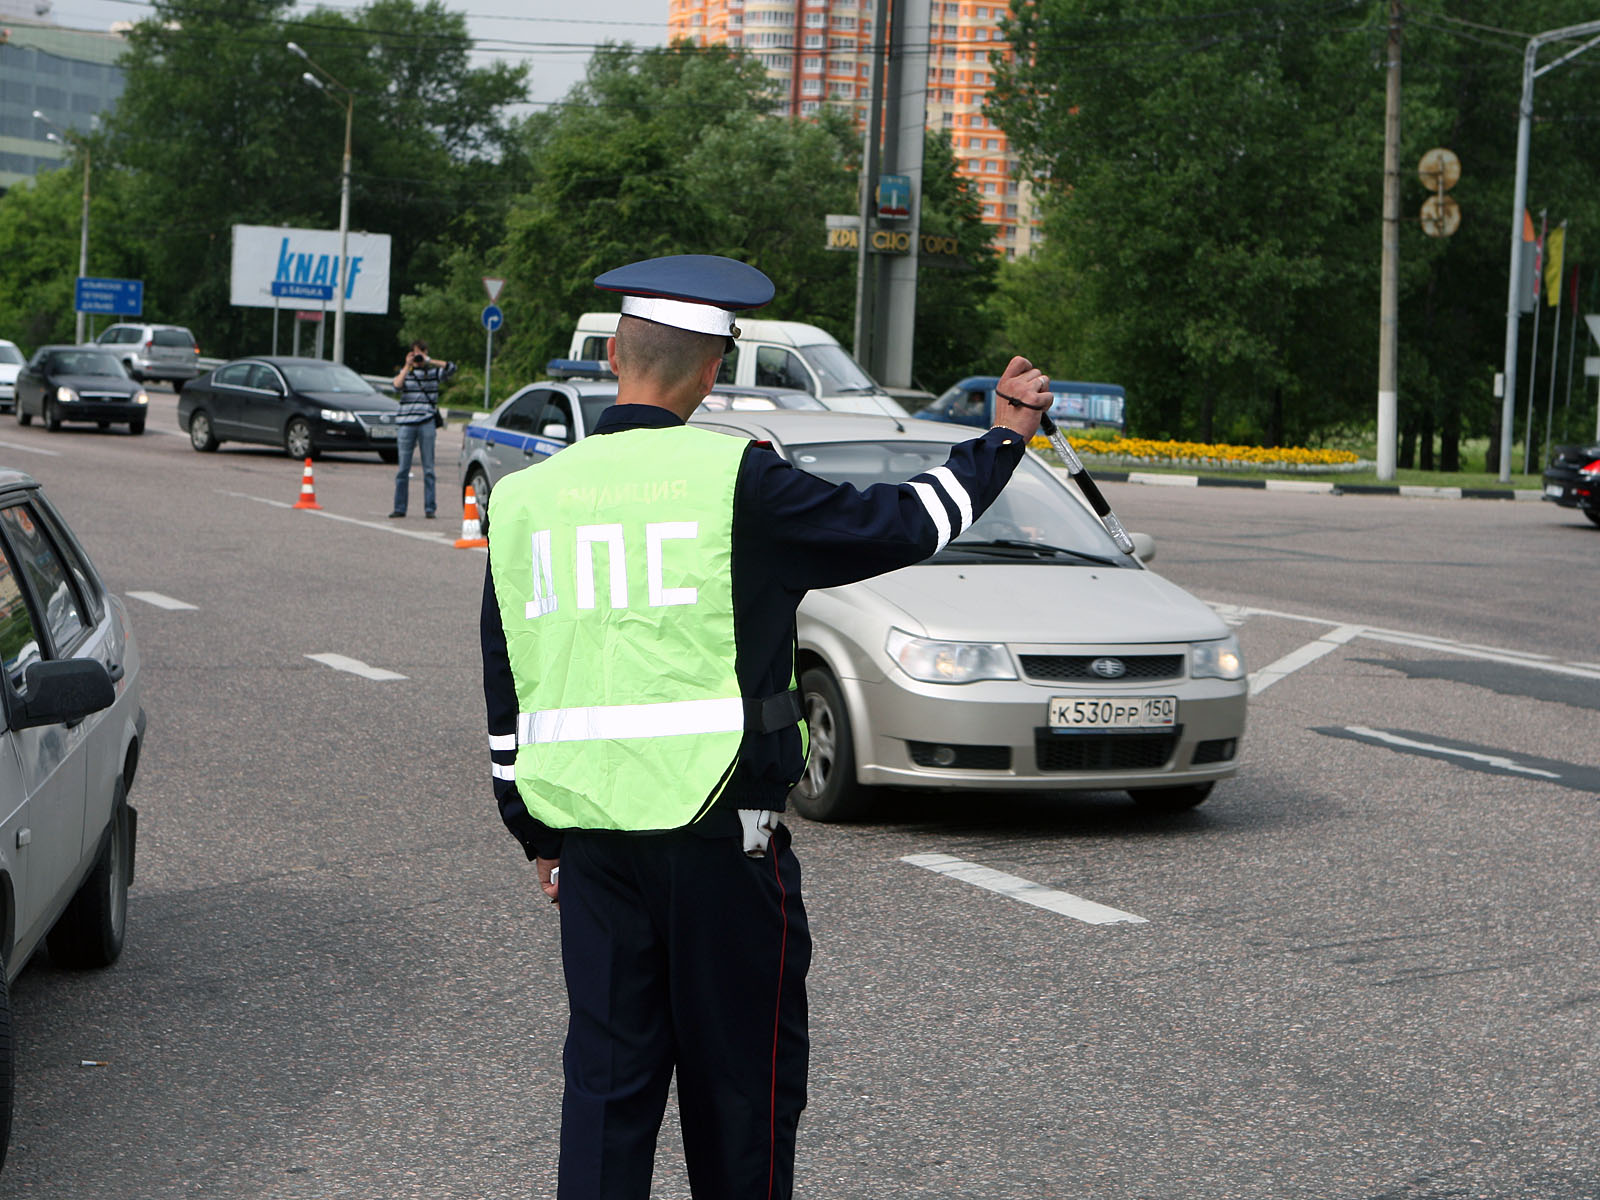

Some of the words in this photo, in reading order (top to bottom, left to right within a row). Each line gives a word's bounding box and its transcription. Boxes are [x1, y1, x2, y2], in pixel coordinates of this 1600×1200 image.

[276, 237, 364, 300] KNAUF
[525, 521, 698, 619] ДПС
[1058, 702, 1139, 723] К530РР
[1144, 700, 1171, 716] 150
